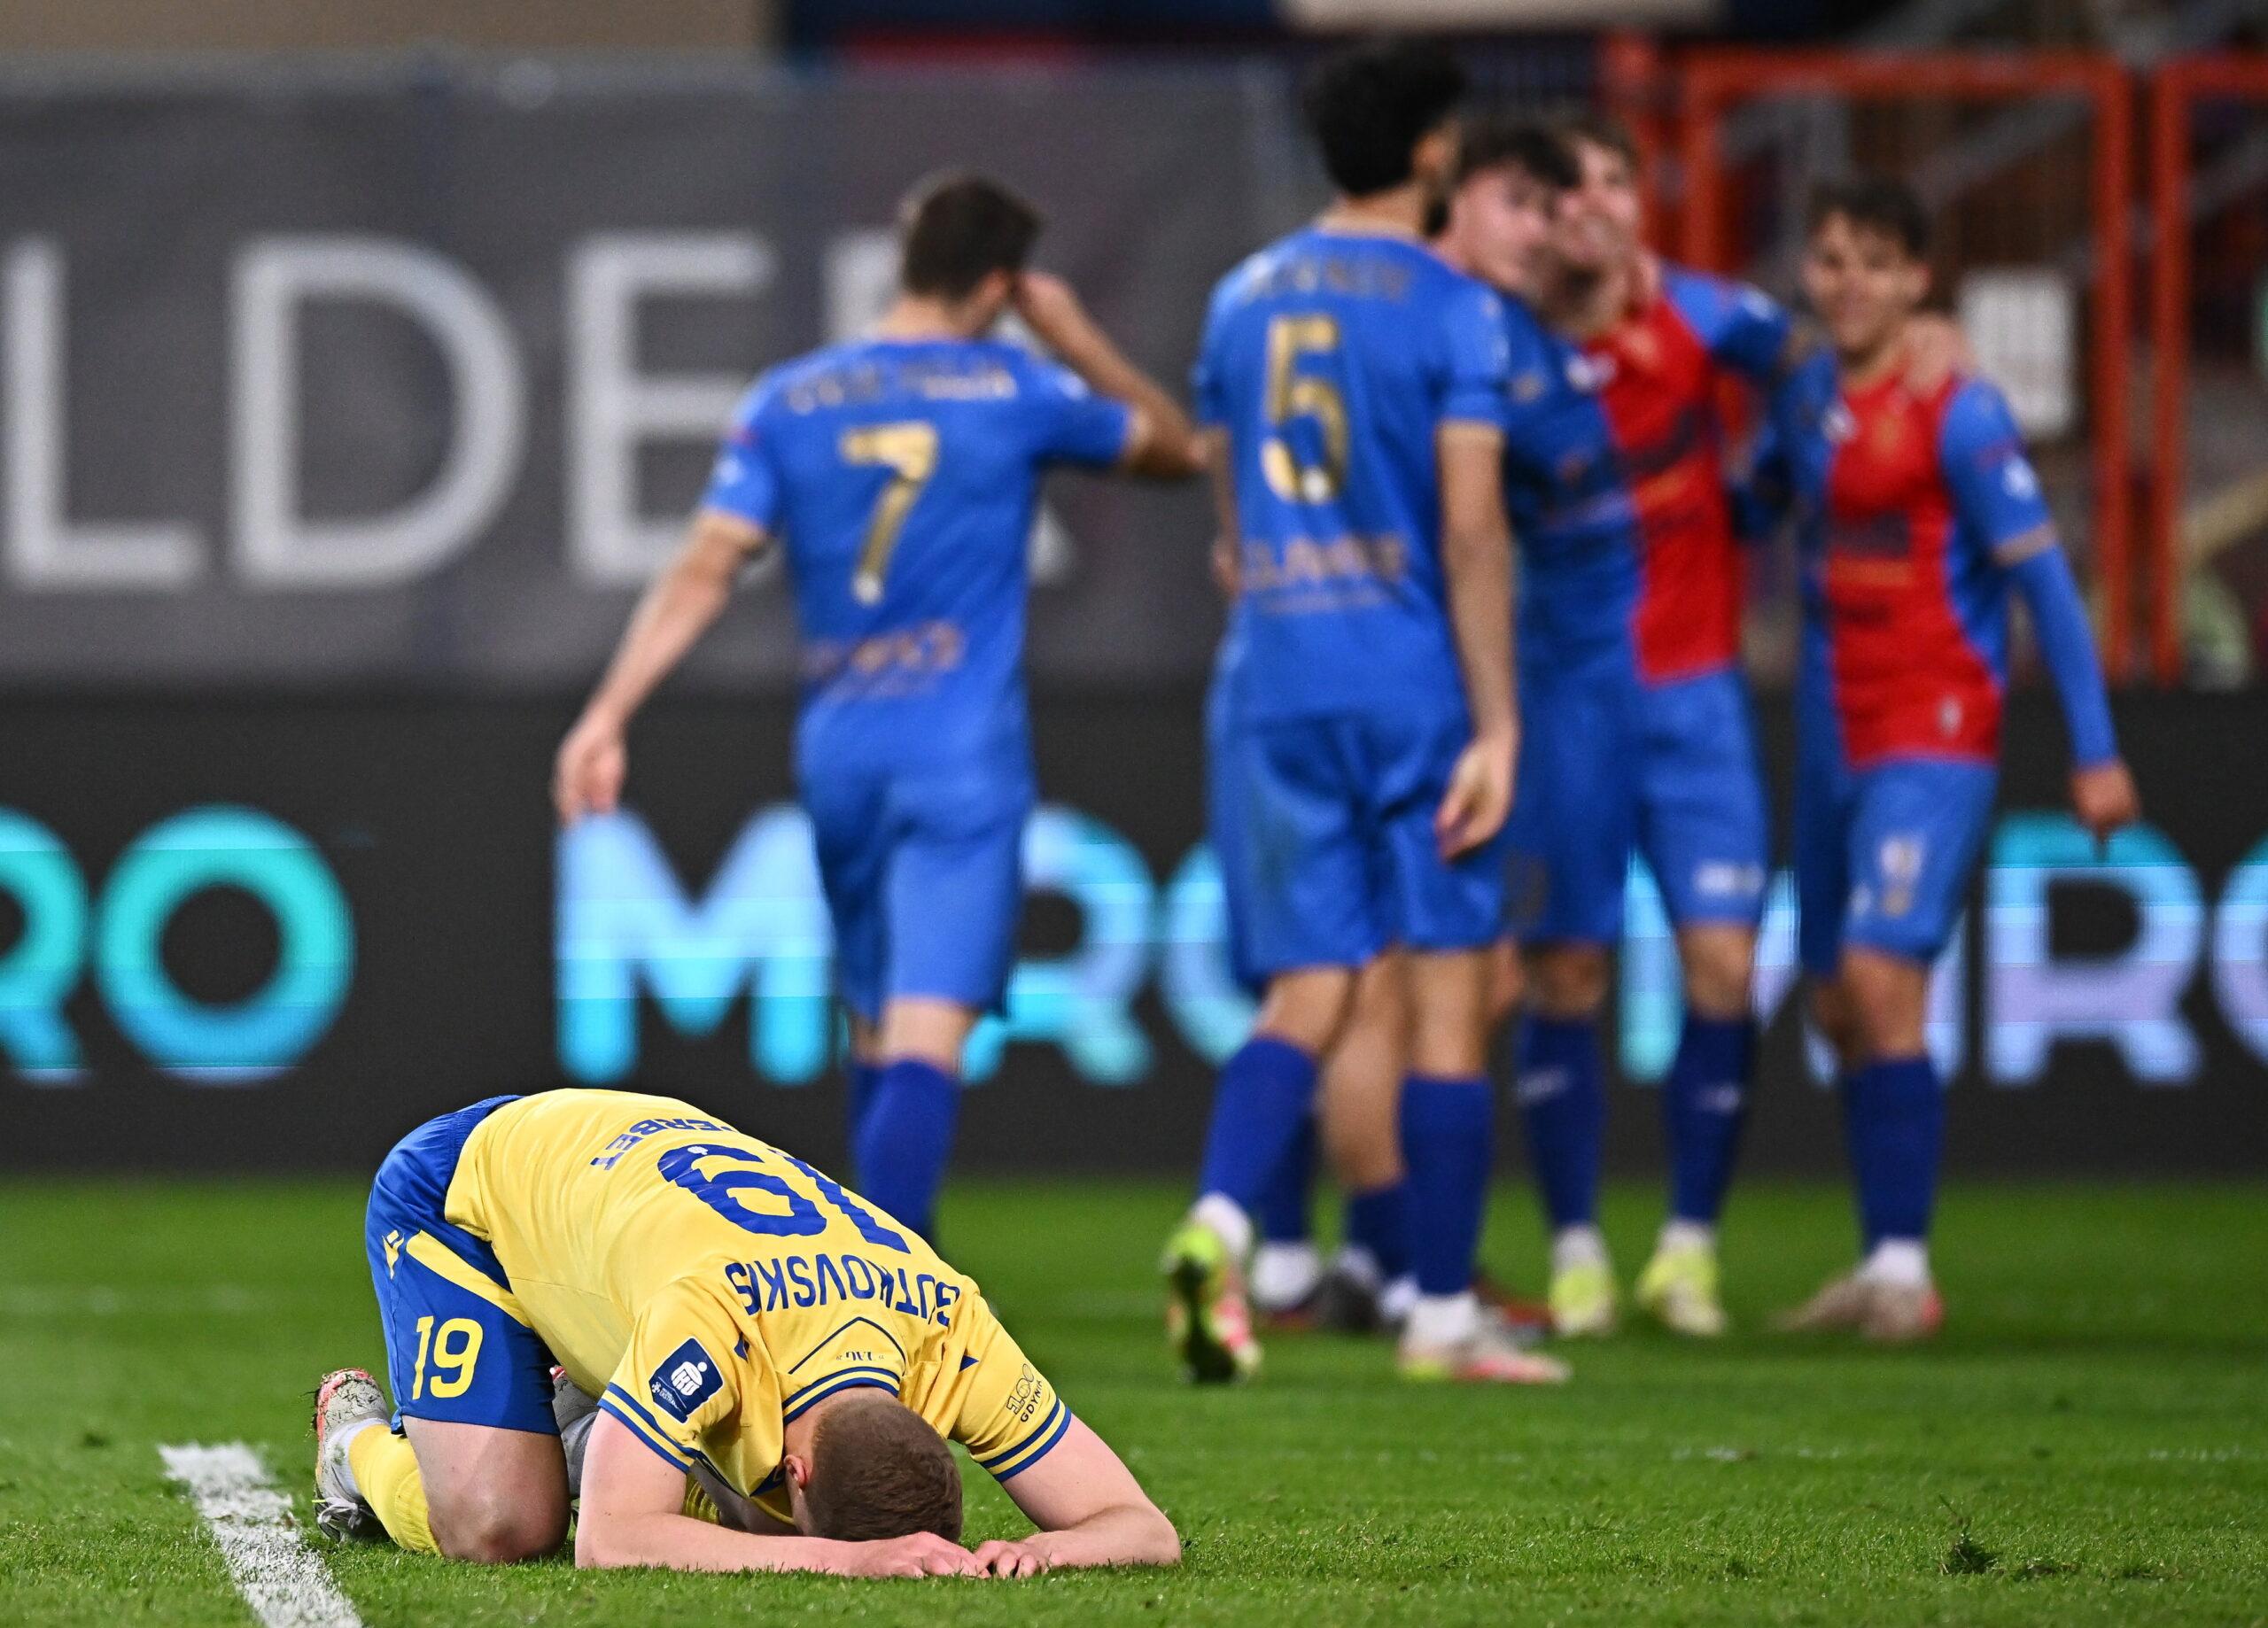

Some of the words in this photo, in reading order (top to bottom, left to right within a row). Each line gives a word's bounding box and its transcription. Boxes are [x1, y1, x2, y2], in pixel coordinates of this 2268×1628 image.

[1260, 313, 1350, 506] 5
[836, 418, 939, 608] 7
[590, 1118, 734, 1171] ERBET
[657, 1143, 912, 1255] 19
[412, 1315, 485, 1400] 19
[1006, 1362, 1035, 1415] 100
[1020, 1379, 1044, 1423] GDYNIA
